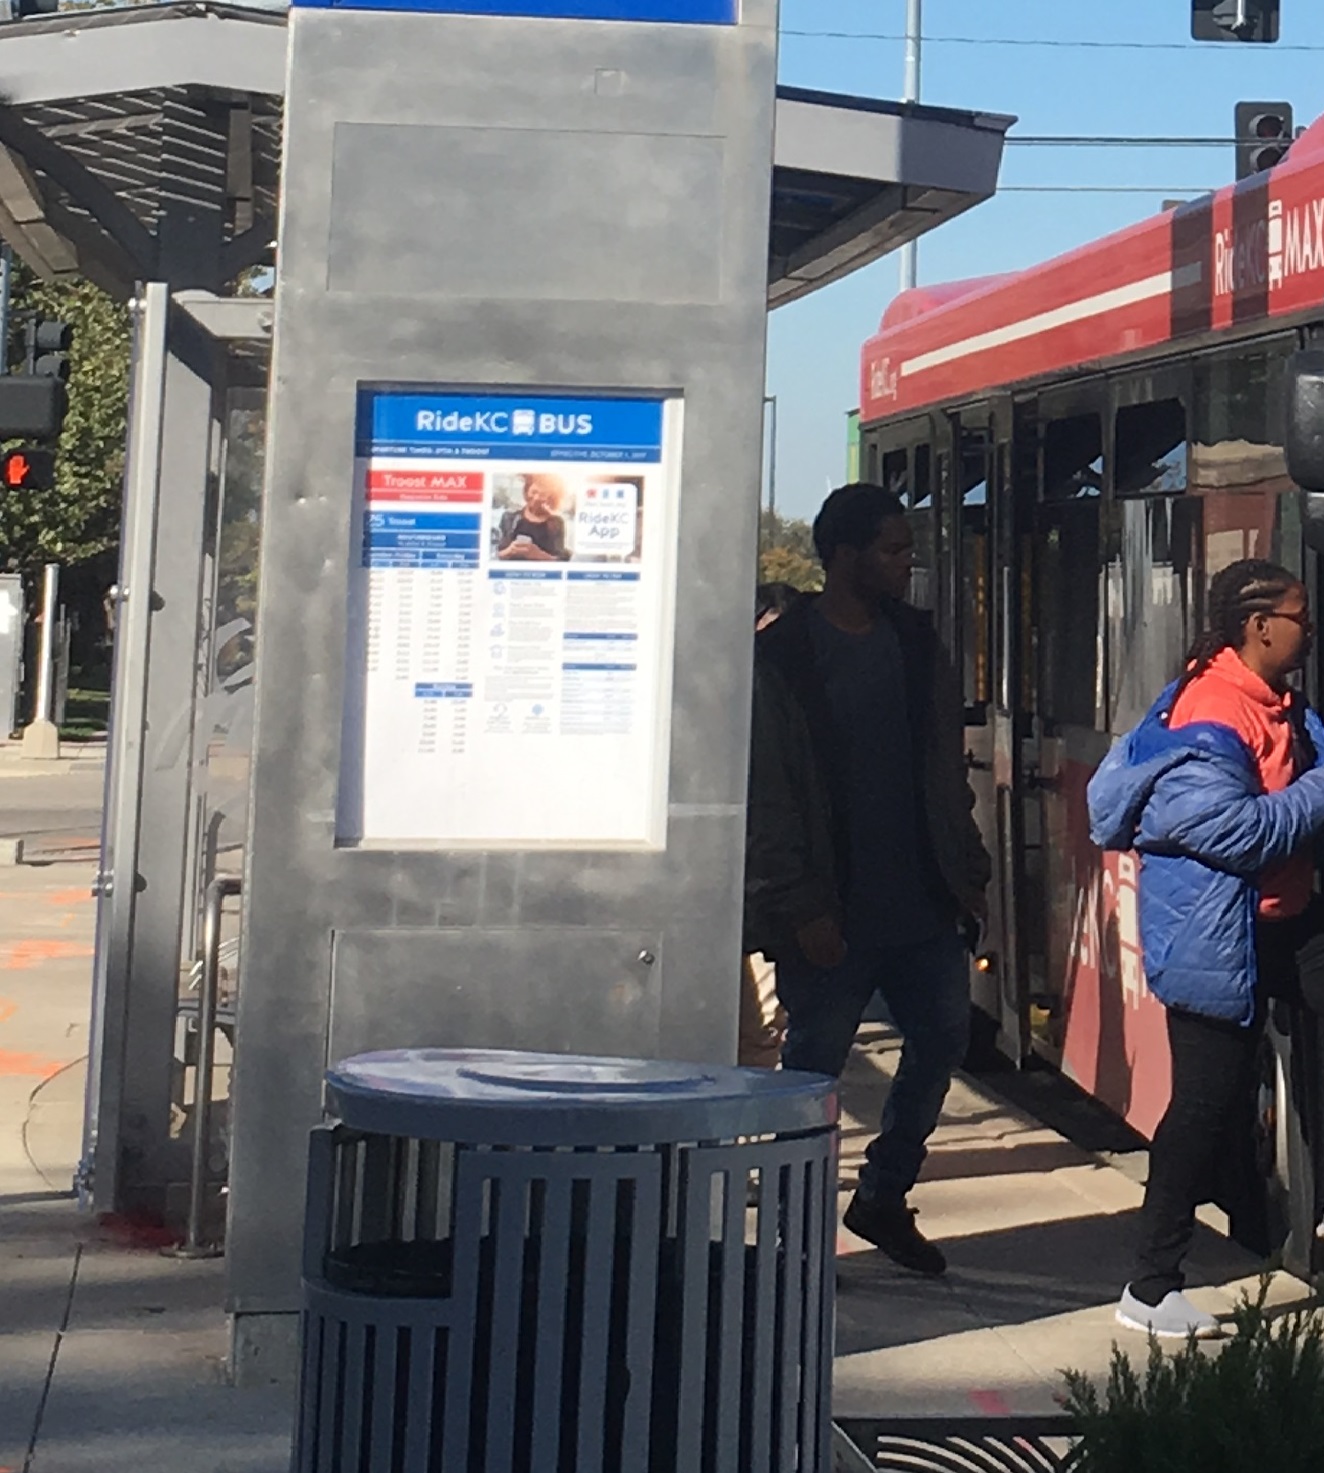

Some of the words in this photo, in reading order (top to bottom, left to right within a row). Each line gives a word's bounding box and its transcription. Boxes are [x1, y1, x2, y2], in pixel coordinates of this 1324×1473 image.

[415, 409, 510, 434] RideKC
[538, 412, 594, 436] BUS
[383, 474, 427, 489] Troost
[430, 475, 468, 489] MAX
[588, 525, 621, 540] App
